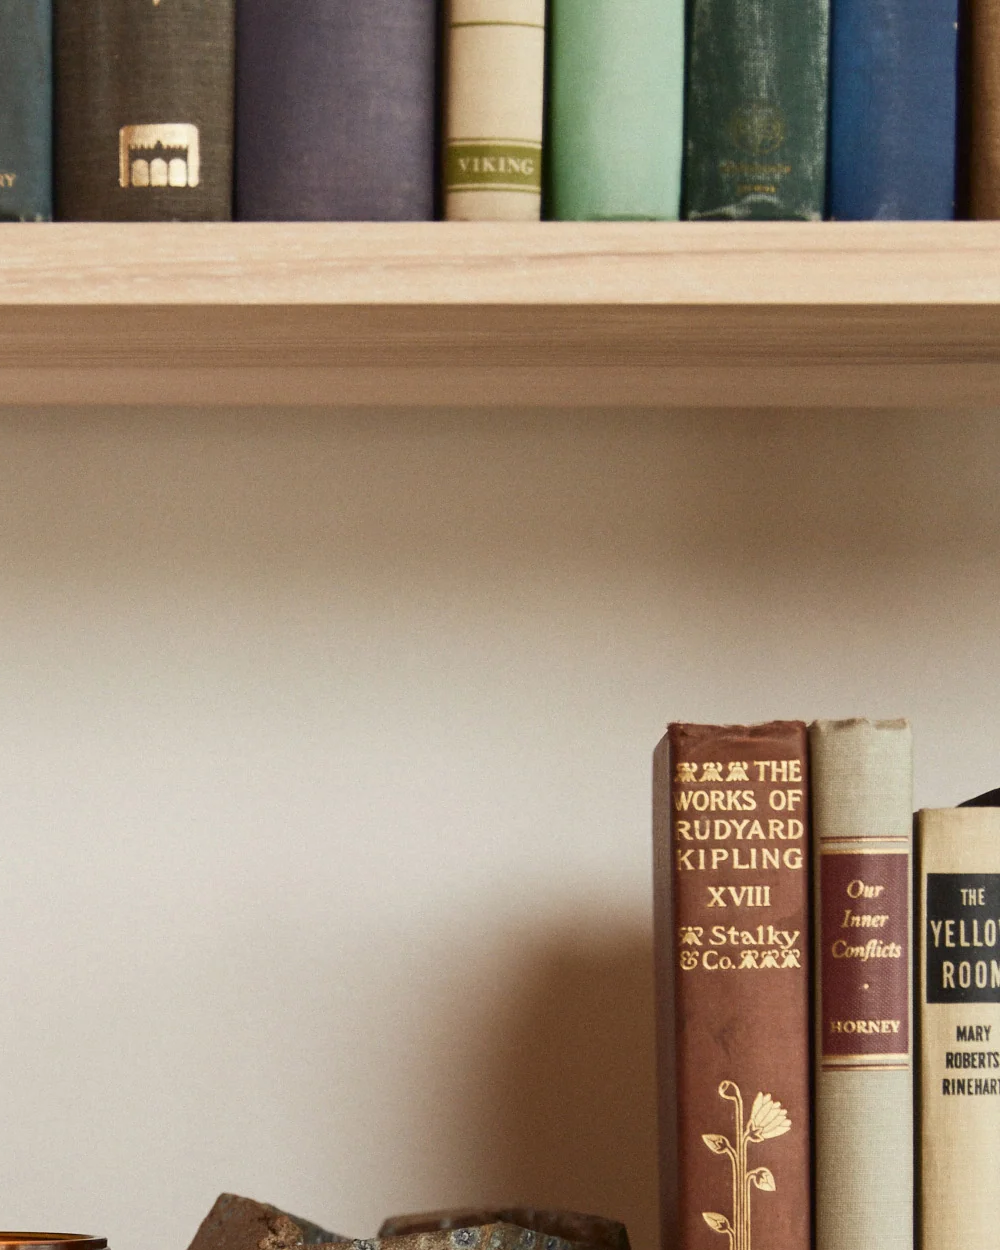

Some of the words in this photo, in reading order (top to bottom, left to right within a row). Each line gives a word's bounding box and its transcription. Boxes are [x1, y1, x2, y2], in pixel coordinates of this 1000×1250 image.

[459, 156, 534, 175] VIKING
[754, 761, 802, 782] THE
[674, 790, 756, 811] WORKS
[769, 790, 803, 810] OF
[677, 819, 804, 840] RUDYARD
[677, 848, 803, 870] KIPLING
[706, 886, 771, 907] XVIII
[847, 880, 884, 899] Our
[960, 888, 985, 905] THE
[841, 910, 889, 928] Inner
[709, 925, 800, 949] Stalky
[930, 919, 1000, 947] YELLO
[680, 951, 698, 970] &
[702, 951, 736, 969] Co.
[832, 939, 901, 962] Conflicts
[831, 1020, 900, 1034] HORNEY
[956, 1025, 991, 1042] MARY
[946, 1052, 1000, 1069] ROBERTS
